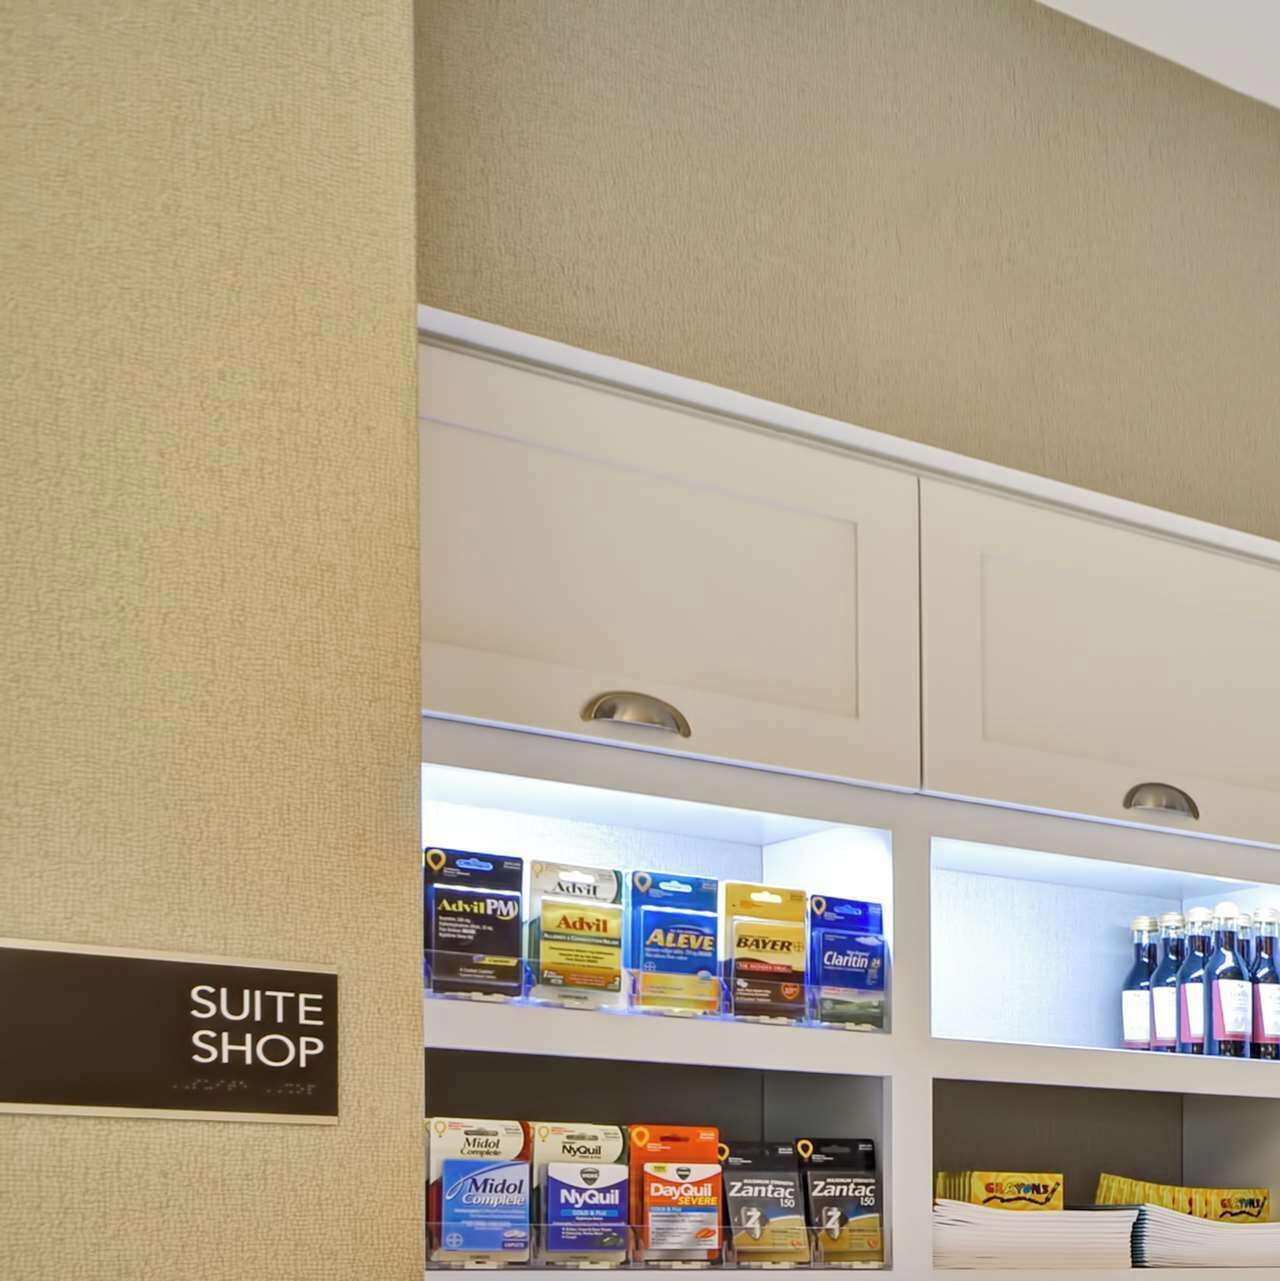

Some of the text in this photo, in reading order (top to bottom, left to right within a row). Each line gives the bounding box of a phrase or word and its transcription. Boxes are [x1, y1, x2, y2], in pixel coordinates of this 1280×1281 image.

[553, 881, 600, 897] Advil
[556, 914, 608, 933] Advil
[645, 928, 715, 951] ALEVE
[736, 935, 792, 952] BAYER
[823, 950, 868, 968] Claritin
[190, 985, 324, 1025] SUITE
[191, 1030, 324, 1068] SHOP
[464, 1137, 501, 1149] Midol
[561, 1144, 602, 1157] NyQuil
[460, 1148, 502, 1158] Complete
[468, 1178, 524, 1194] Midol
[650, 1183, 713, 1200] DayQuil
[729, 1181, 796, 1199] Zantac
[812, 1181, 876, 1198] Zantac
[985, 1182, 1050, 1195] CRAYONS
[462, 1193, 525, 1208] Complete
[560, 1189, 620, 1207] NyQuil
[678, 1196, 718, 1206] SEVERE
[780, 1198, 796, 1208] 150
[859, 1197, 876, 1207] 150
